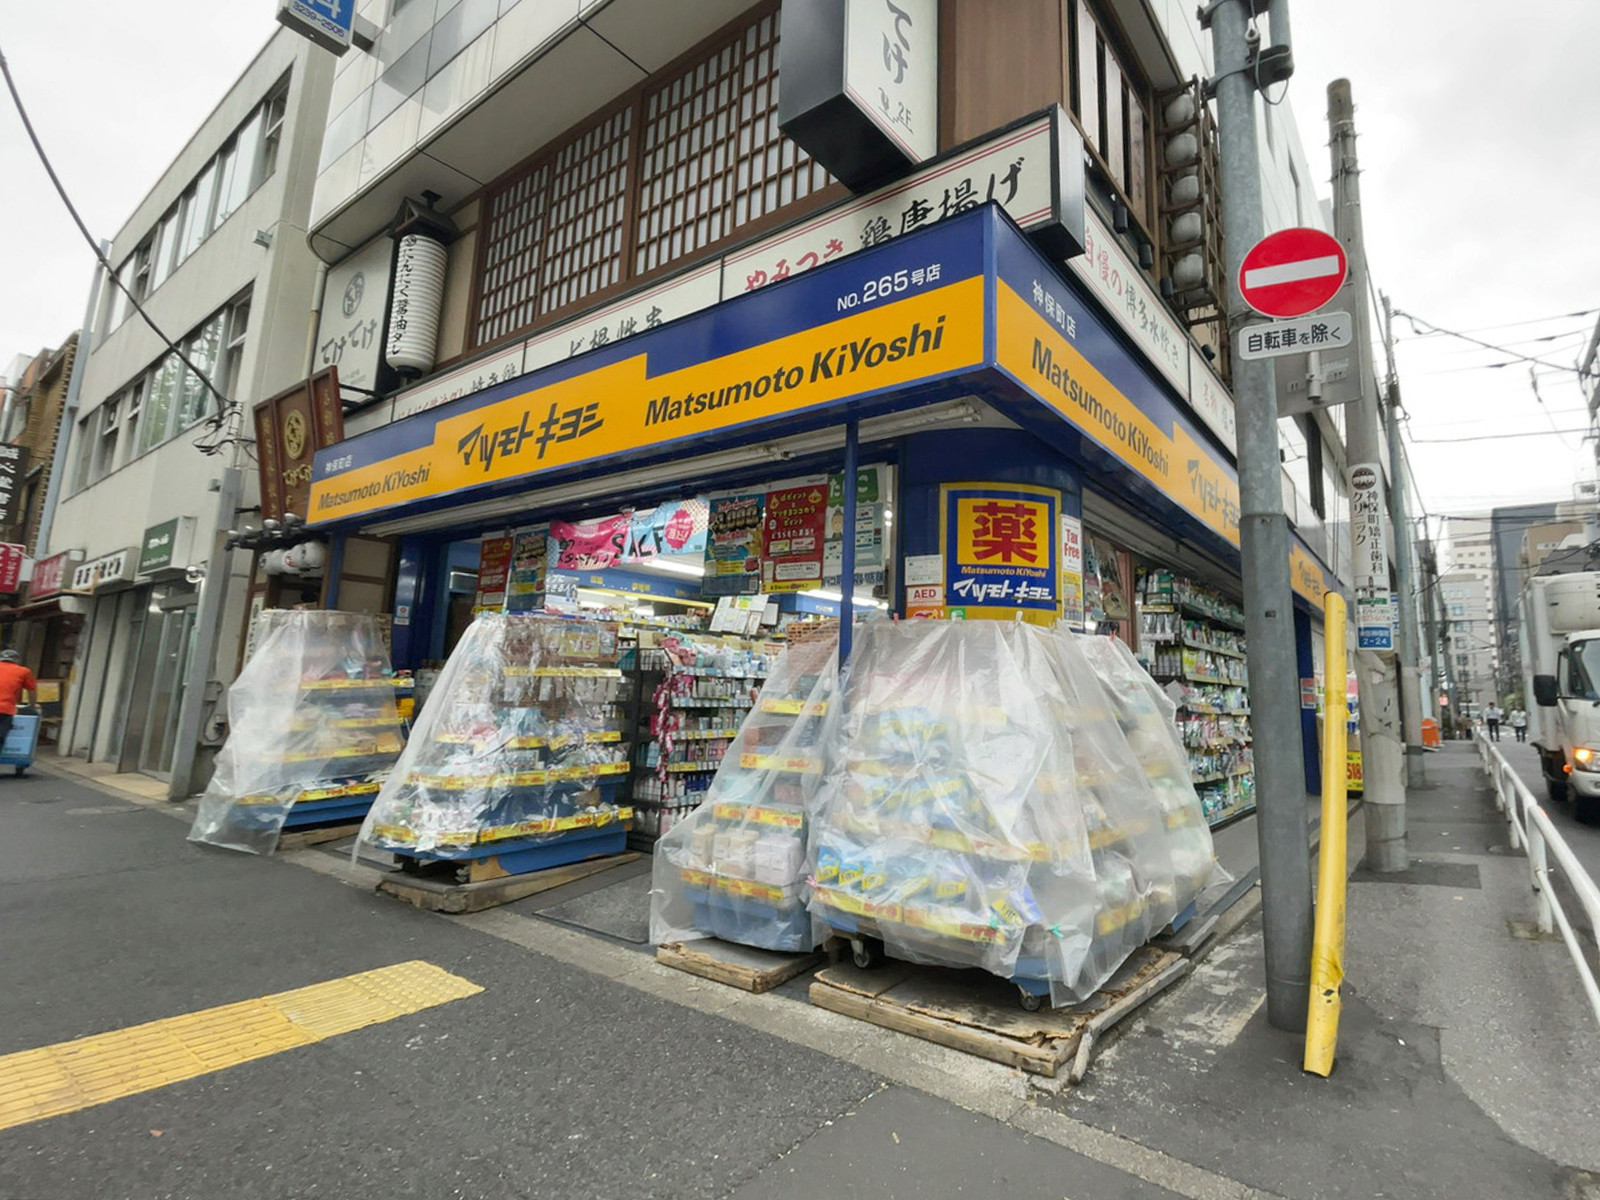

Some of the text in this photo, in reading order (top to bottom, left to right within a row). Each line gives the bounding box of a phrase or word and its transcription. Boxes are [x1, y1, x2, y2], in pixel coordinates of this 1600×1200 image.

[1033, 279, 1077, 340] 神保町店
[1248, 323, 1341, 353] 自転車を除く
[644, 315, 947, 426] Matsumoto KiYoshi
[1033, 337, 1126, 441] Matsumoto
[1128, 422, 1169, 478] KiYoshi
[457, 402, 604, 472] マツモトキヨシ
[317, 482, 380, 510] Matsumoto
[382, 462, 432, 493] KiYoshi
[972, 502, 1038, 563] 薬
[1065, 528, 1078, 545] Tax
[1353, 492, 1366, 546] クリニック
[1064, 543, 1080, 559] Free
[953, 578, 1052, 603] マツモトキヨシ
[961, 566, 1047, 578] Matsumoto KiYoshi
[913, 588, 937, 599] AED
[1362, 637, 1388, 646] 2-24
